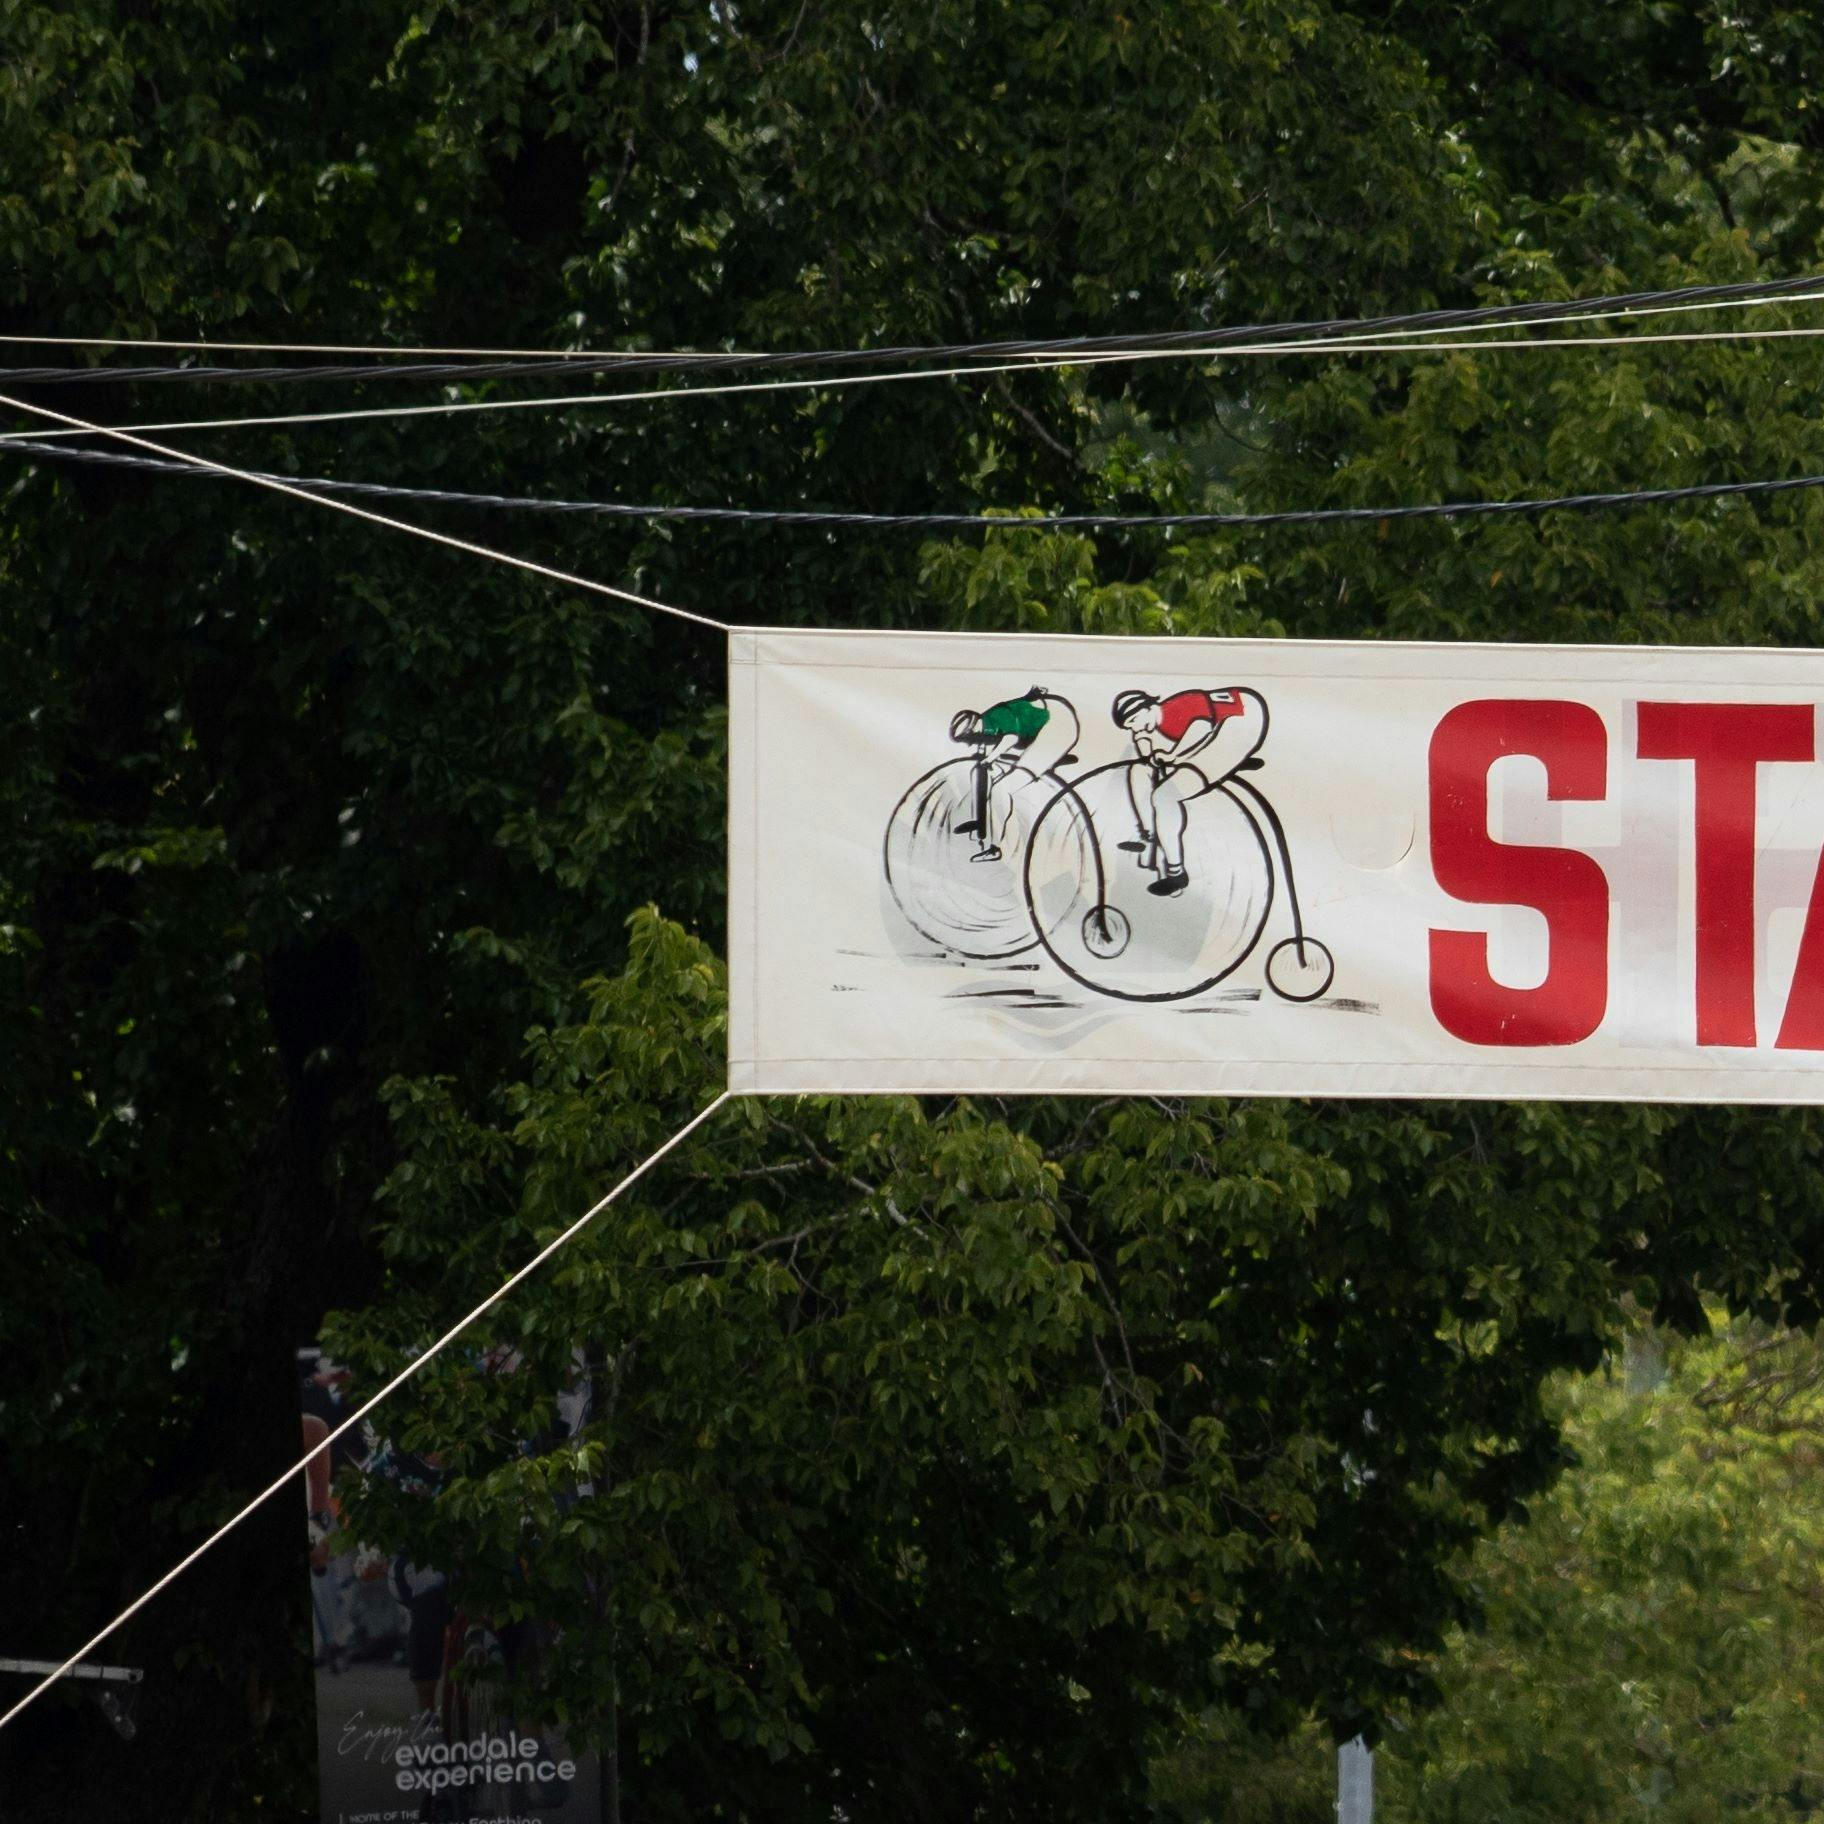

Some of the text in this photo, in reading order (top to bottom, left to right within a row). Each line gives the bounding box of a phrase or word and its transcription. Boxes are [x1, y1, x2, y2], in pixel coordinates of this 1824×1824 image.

[395, 1731, 538, 1767] evandale
[396, 1757, 577, 1795] experience
[349, 1810, 420, 1824] HOME OF THE
